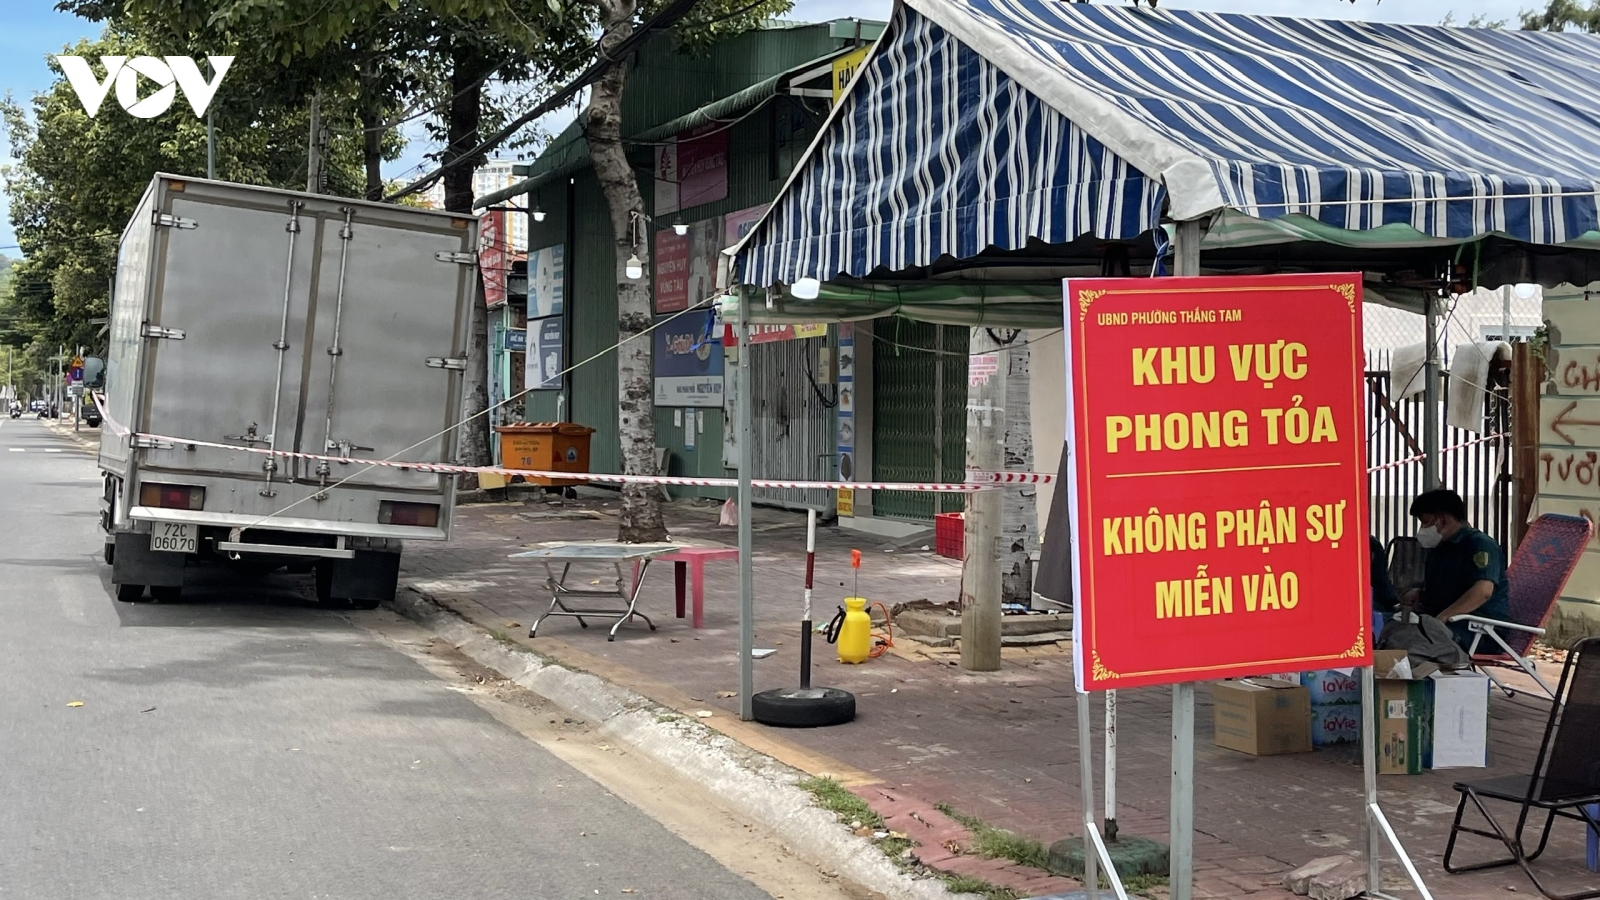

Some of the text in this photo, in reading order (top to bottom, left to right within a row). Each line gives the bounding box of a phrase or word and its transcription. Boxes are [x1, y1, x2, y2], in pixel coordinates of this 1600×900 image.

[1097, 306, 1242, 326] UBND PHƯỜNG THẮNG TAM
[1132, 339, 1308, 389] KHU VỰC
[1106, 394, 1338, 453] PHONG TỎA
[164, 523, 188, 538] 72C
[1103, 500, 1347, 556] KHÔNG PHẬN SỰ
[1155, 564, 1299, 619] MIỄN VÀO
